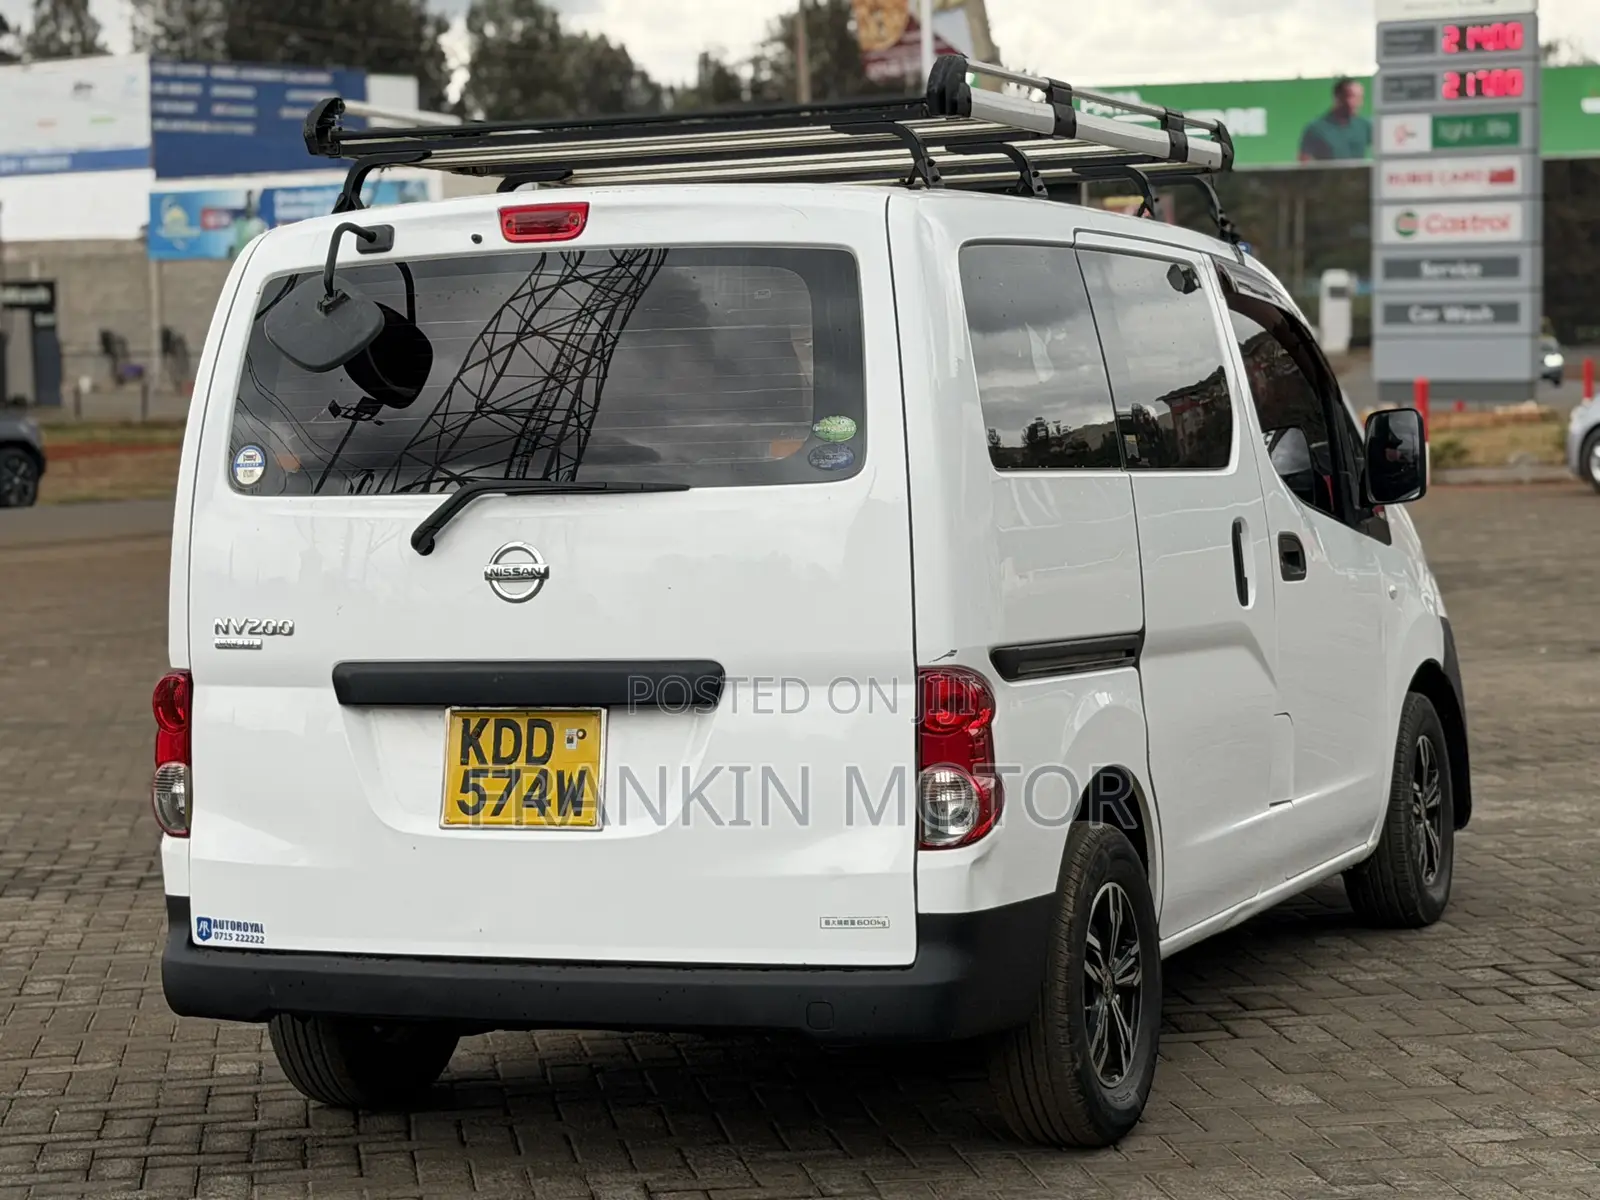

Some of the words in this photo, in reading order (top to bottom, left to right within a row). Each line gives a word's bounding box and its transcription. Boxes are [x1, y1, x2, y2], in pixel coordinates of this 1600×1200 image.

[1425, 213, 1511, 235] Castrol
[1420, 260, 1483, 278] Service
[1408, 305, 1440, 323] Car
[1442, 304, 1494, 323] Wash
[489, 567, 542, 577] NISSAN
[214, 618, 295, 636] NV200
[460, 718, 555, 766] KDD
[456, 769, 587, 817] 574W
[213, 919, 265, 934] AUTOROYAL
[214, 931, 233, 941] 0715
[235, 933, 265, 944] 222222
